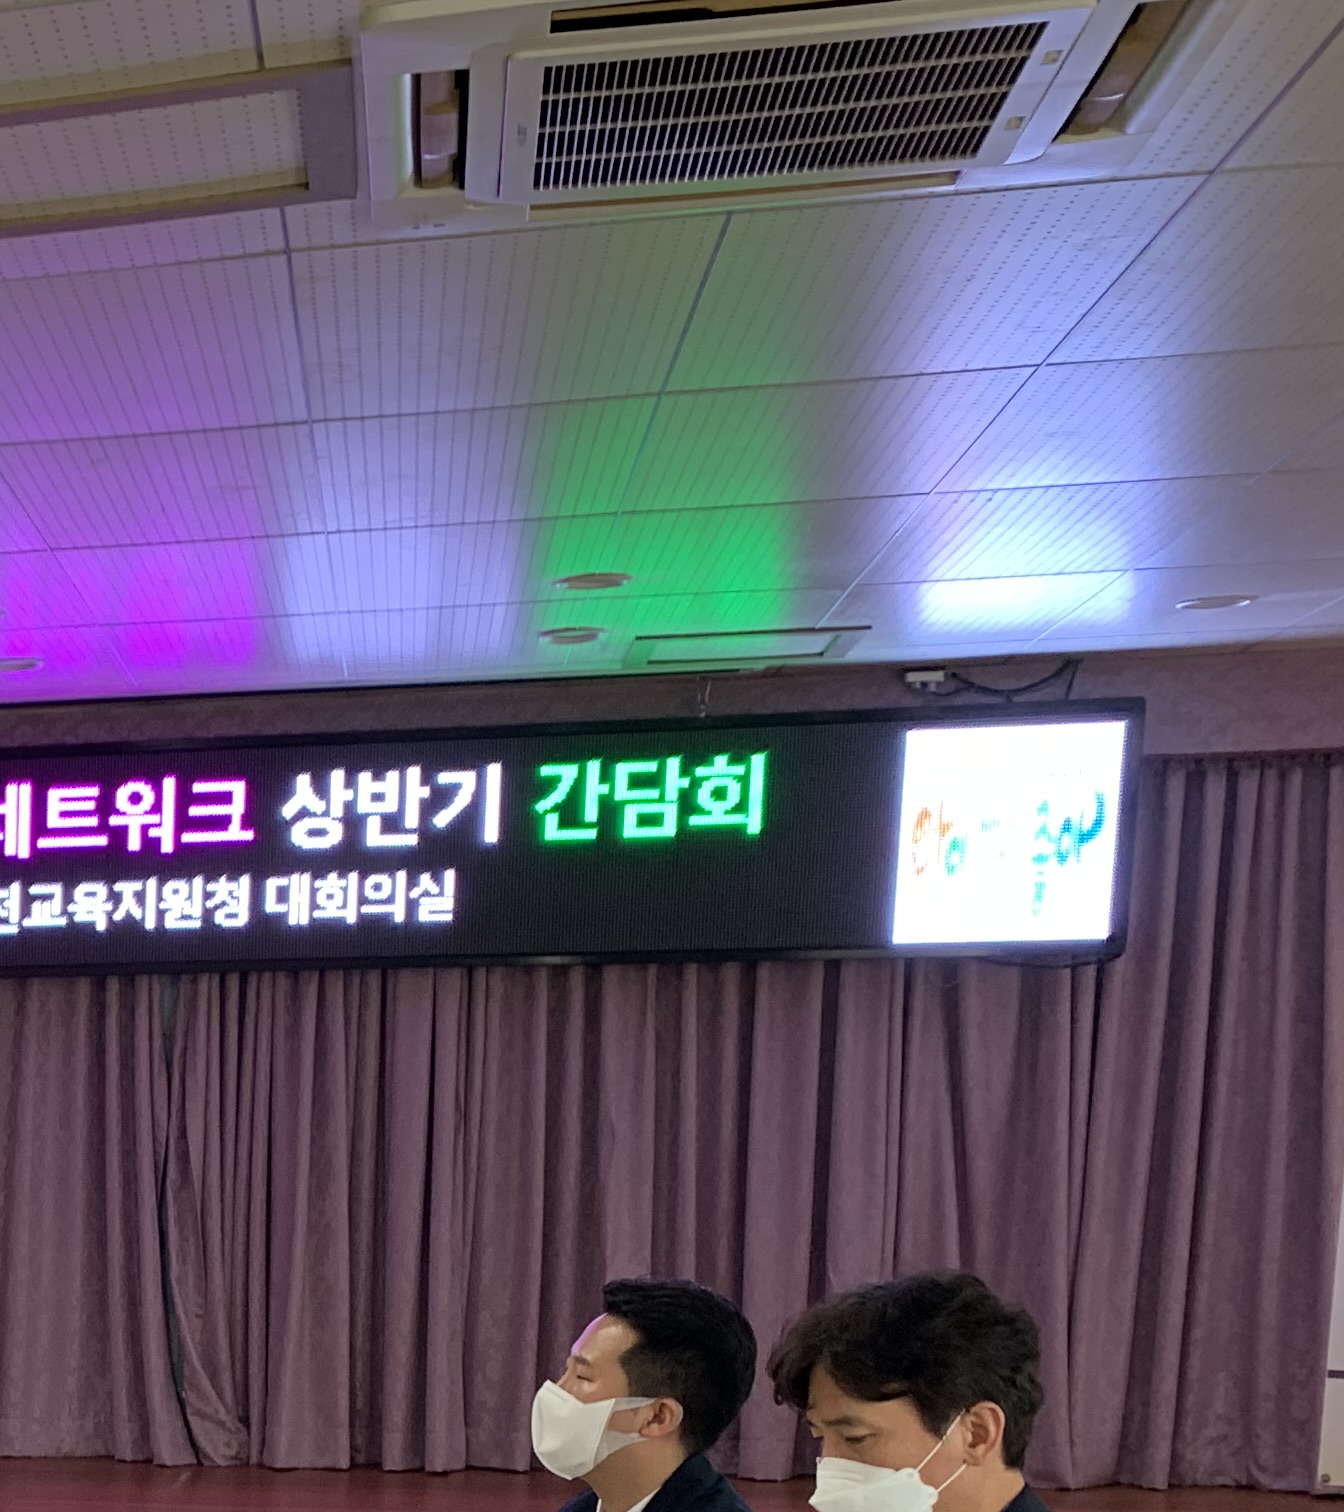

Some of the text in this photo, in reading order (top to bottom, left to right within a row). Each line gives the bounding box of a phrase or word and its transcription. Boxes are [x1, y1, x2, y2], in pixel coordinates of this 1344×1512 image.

[281, 762, 502, 850] 상반기
[534, 752, 767, 842] 간담회
[264, 868, 457, 926] 대회의실
